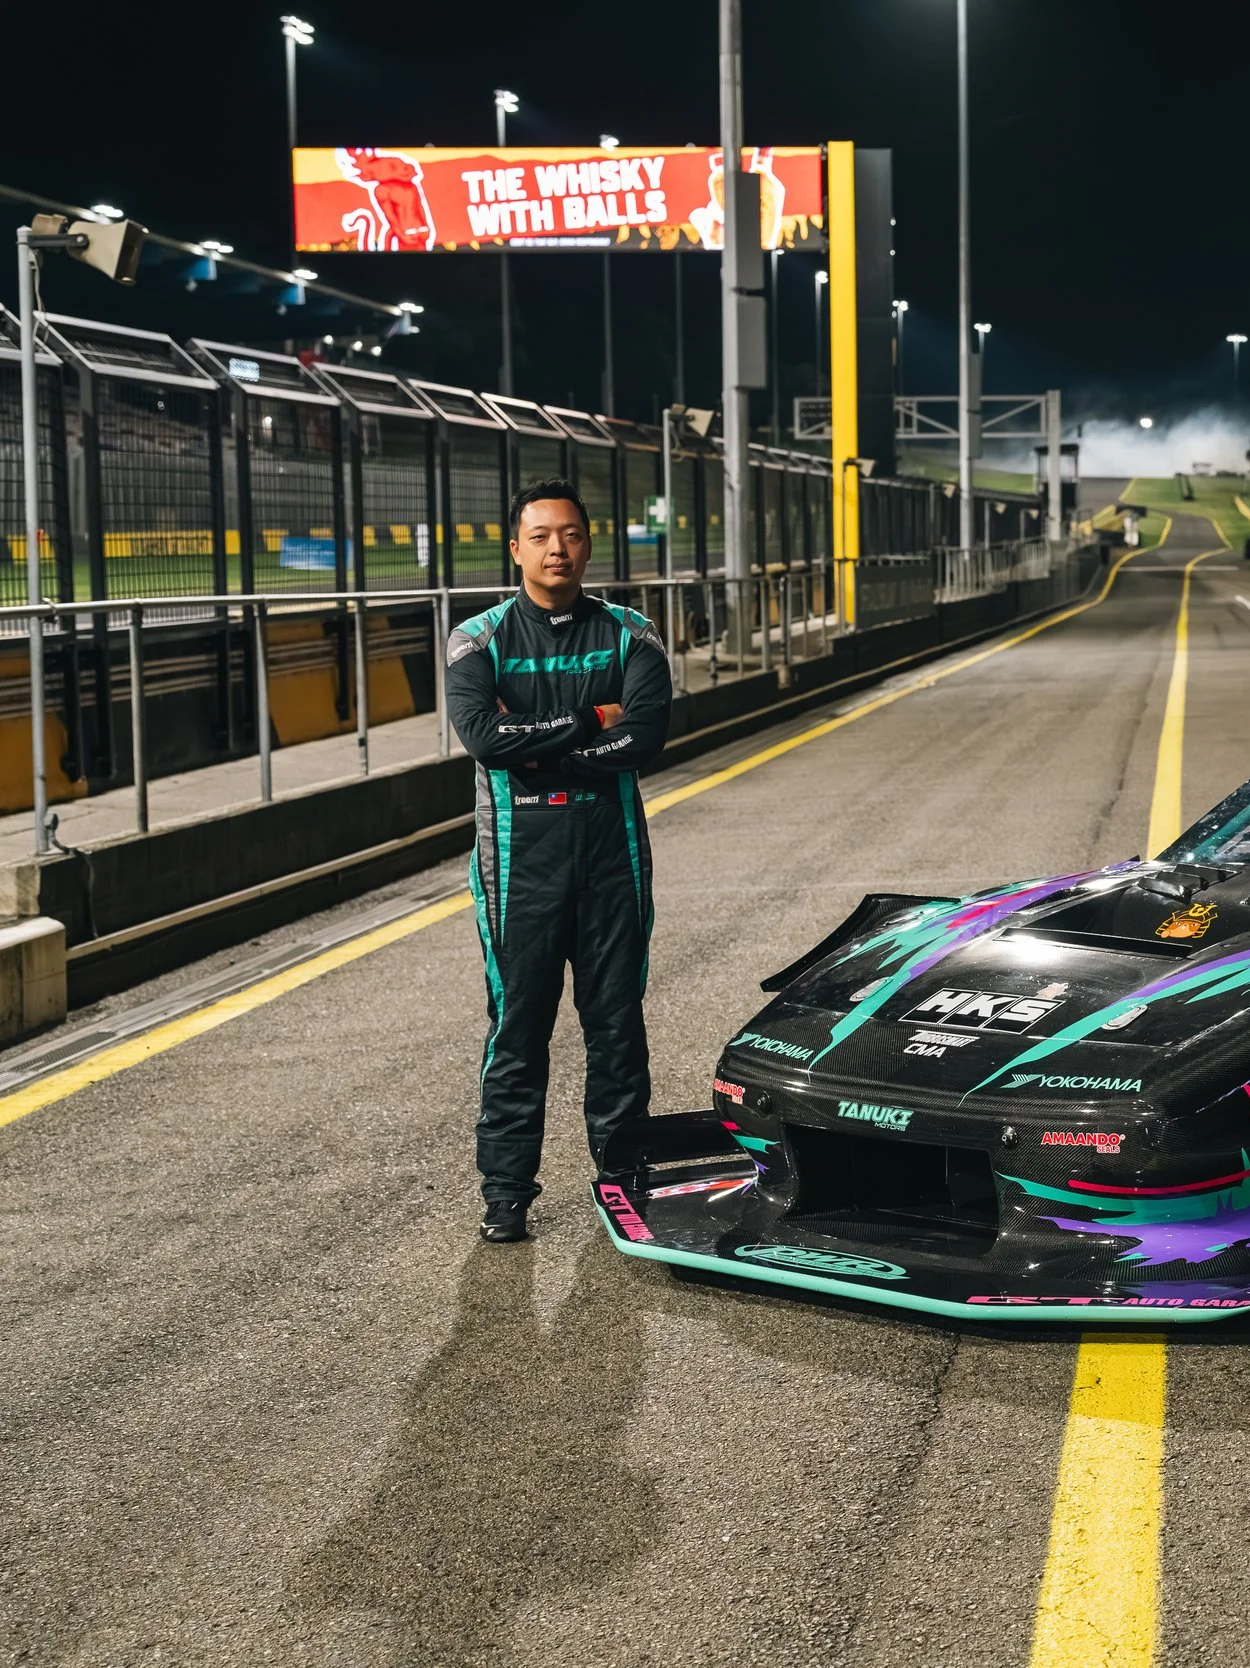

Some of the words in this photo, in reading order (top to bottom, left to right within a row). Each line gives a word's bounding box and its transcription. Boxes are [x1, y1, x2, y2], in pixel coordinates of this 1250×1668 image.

[461, 167, 527, 203] THE
[534, 156, 665, 197] WHISKY
[467, 199, 555, 237] WITH
[562, 190, 668, 229] BALLS
[549, 612, 573, 626] freem
[498, 725, 535, 733] GT
[535, 721, 551, 730] AUTO
[596, 744, 611, 756] AUTO
[515, 794, 539, 805] freem
[915, 990, 1059, 1023] HKS
[750, 1034, 814, 1061] YOKOHAMA
[903, 1043, 947, 1057] CMA
[1039, 1075, 1142, 1092] YOKOHAMA
[837, 1100, 914, 1126] TANUKI
[874, 1122, 906, 1132] MOTORS
[1041, 1131, 1121, 1147] AMAANDO
[1097, 1144, 1120, 1154] SEALS
[599, 1184, 636, 1214] GT
[1122, 1297, 1184, 1306] AUTO
